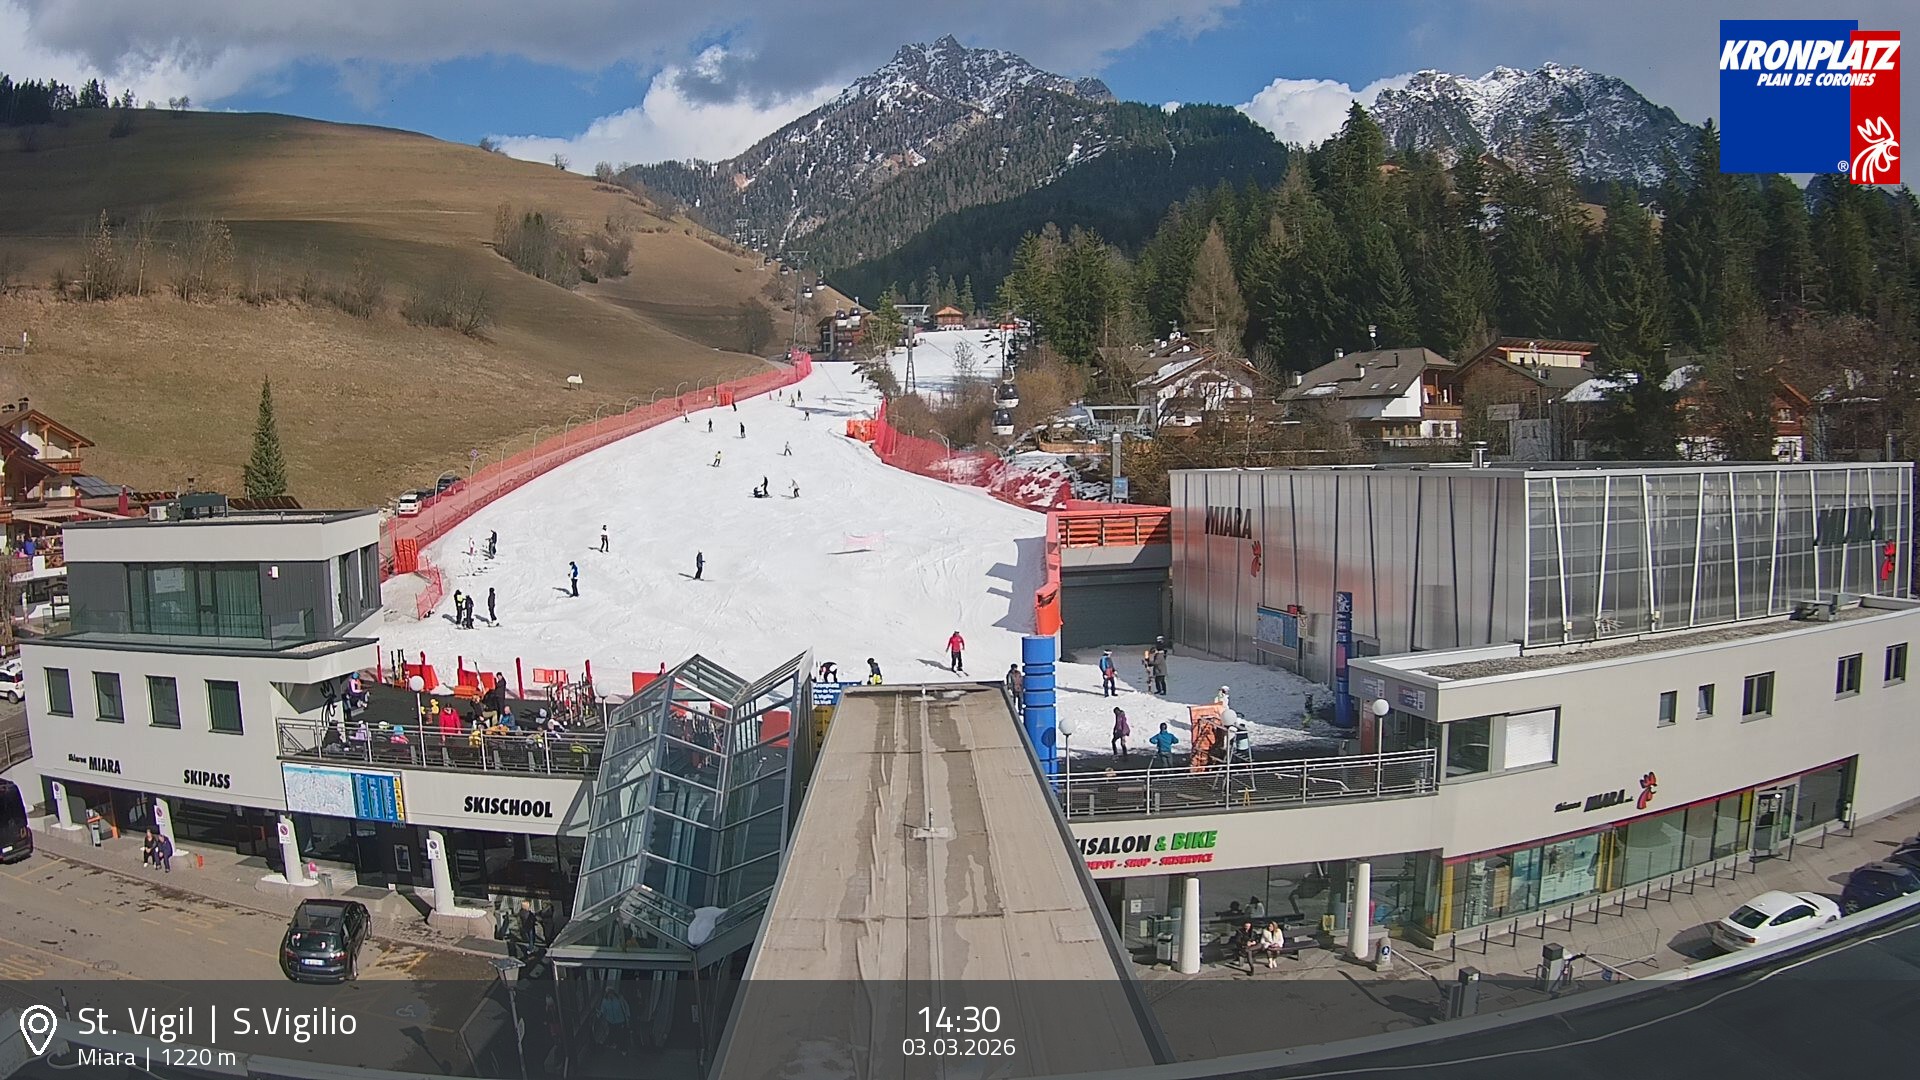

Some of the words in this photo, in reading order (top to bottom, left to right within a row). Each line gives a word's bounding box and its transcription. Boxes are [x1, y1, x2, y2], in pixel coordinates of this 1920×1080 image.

[1205, 506, 1252, 539] MIARA
[89, 756, 121, 774] MIARA
[184, 769, 231, 789] SKIPASS
[464, 796, 553, 818] SKISCHOOL
[1154, 836, 1167, 851] &
[1171, 830, 1218, 850] BIKE
